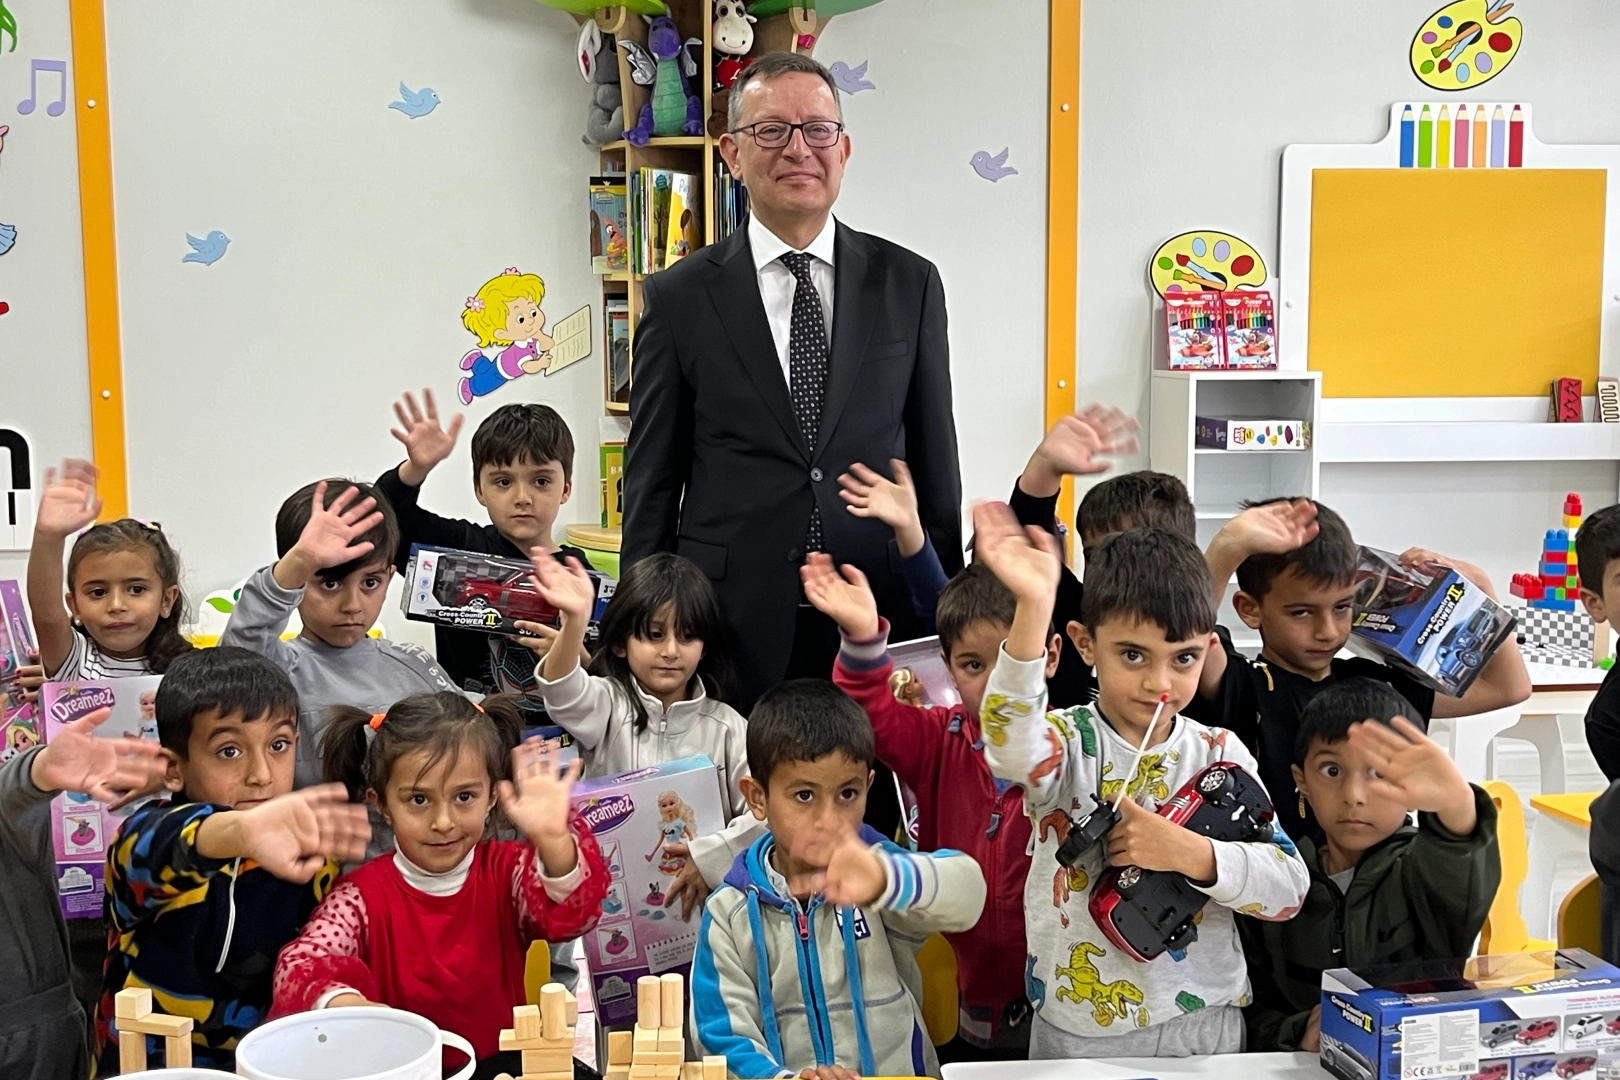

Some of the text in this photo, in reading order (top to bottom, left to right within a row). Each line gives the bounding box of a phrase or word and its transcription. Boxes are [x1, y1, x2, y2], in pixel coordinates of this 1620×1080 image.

[454, 617, 484, 625] POWER
[1433, 601, 1456, 632] POWER
[518, 628, 537, 637] SU
